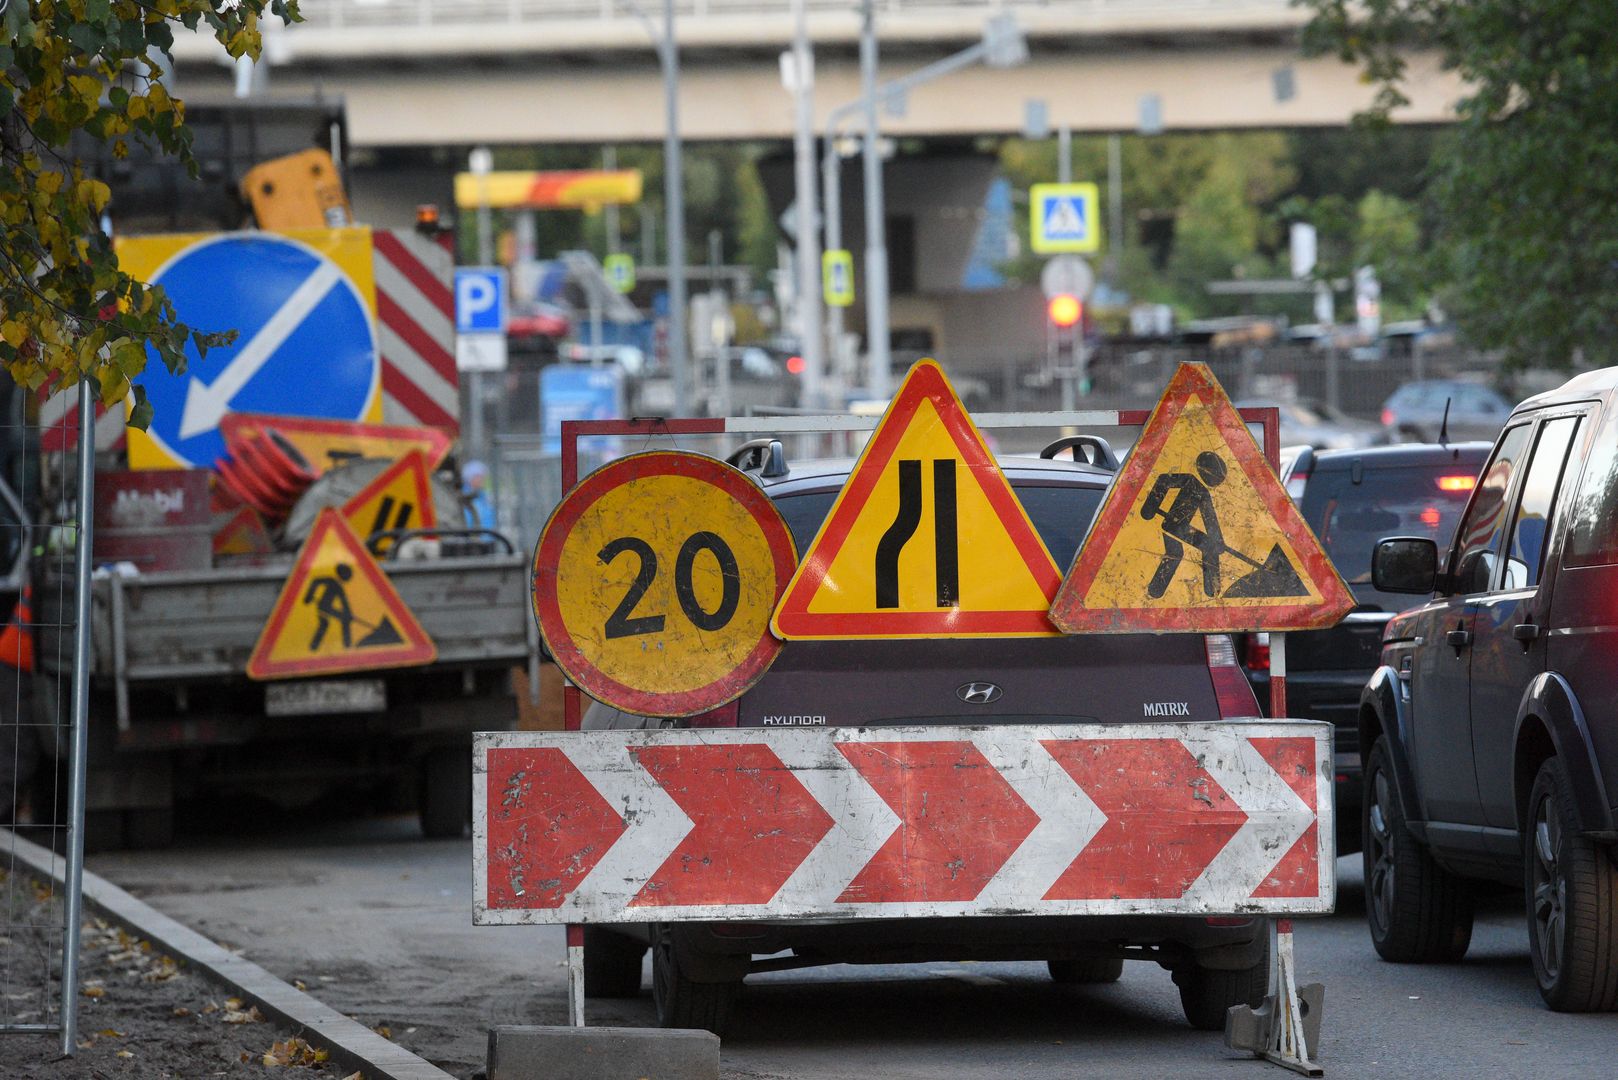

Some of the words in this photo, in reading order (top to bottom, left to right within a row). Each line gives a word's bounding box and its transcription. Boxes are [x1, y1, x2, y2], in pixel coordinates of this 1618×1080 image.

[458, 274, 496, 329] P
[597, 531, 741, 640] 20
[763, 715, 826, 725] HYUNDAI
[1143, 702, 1190, 717] MATRIX
